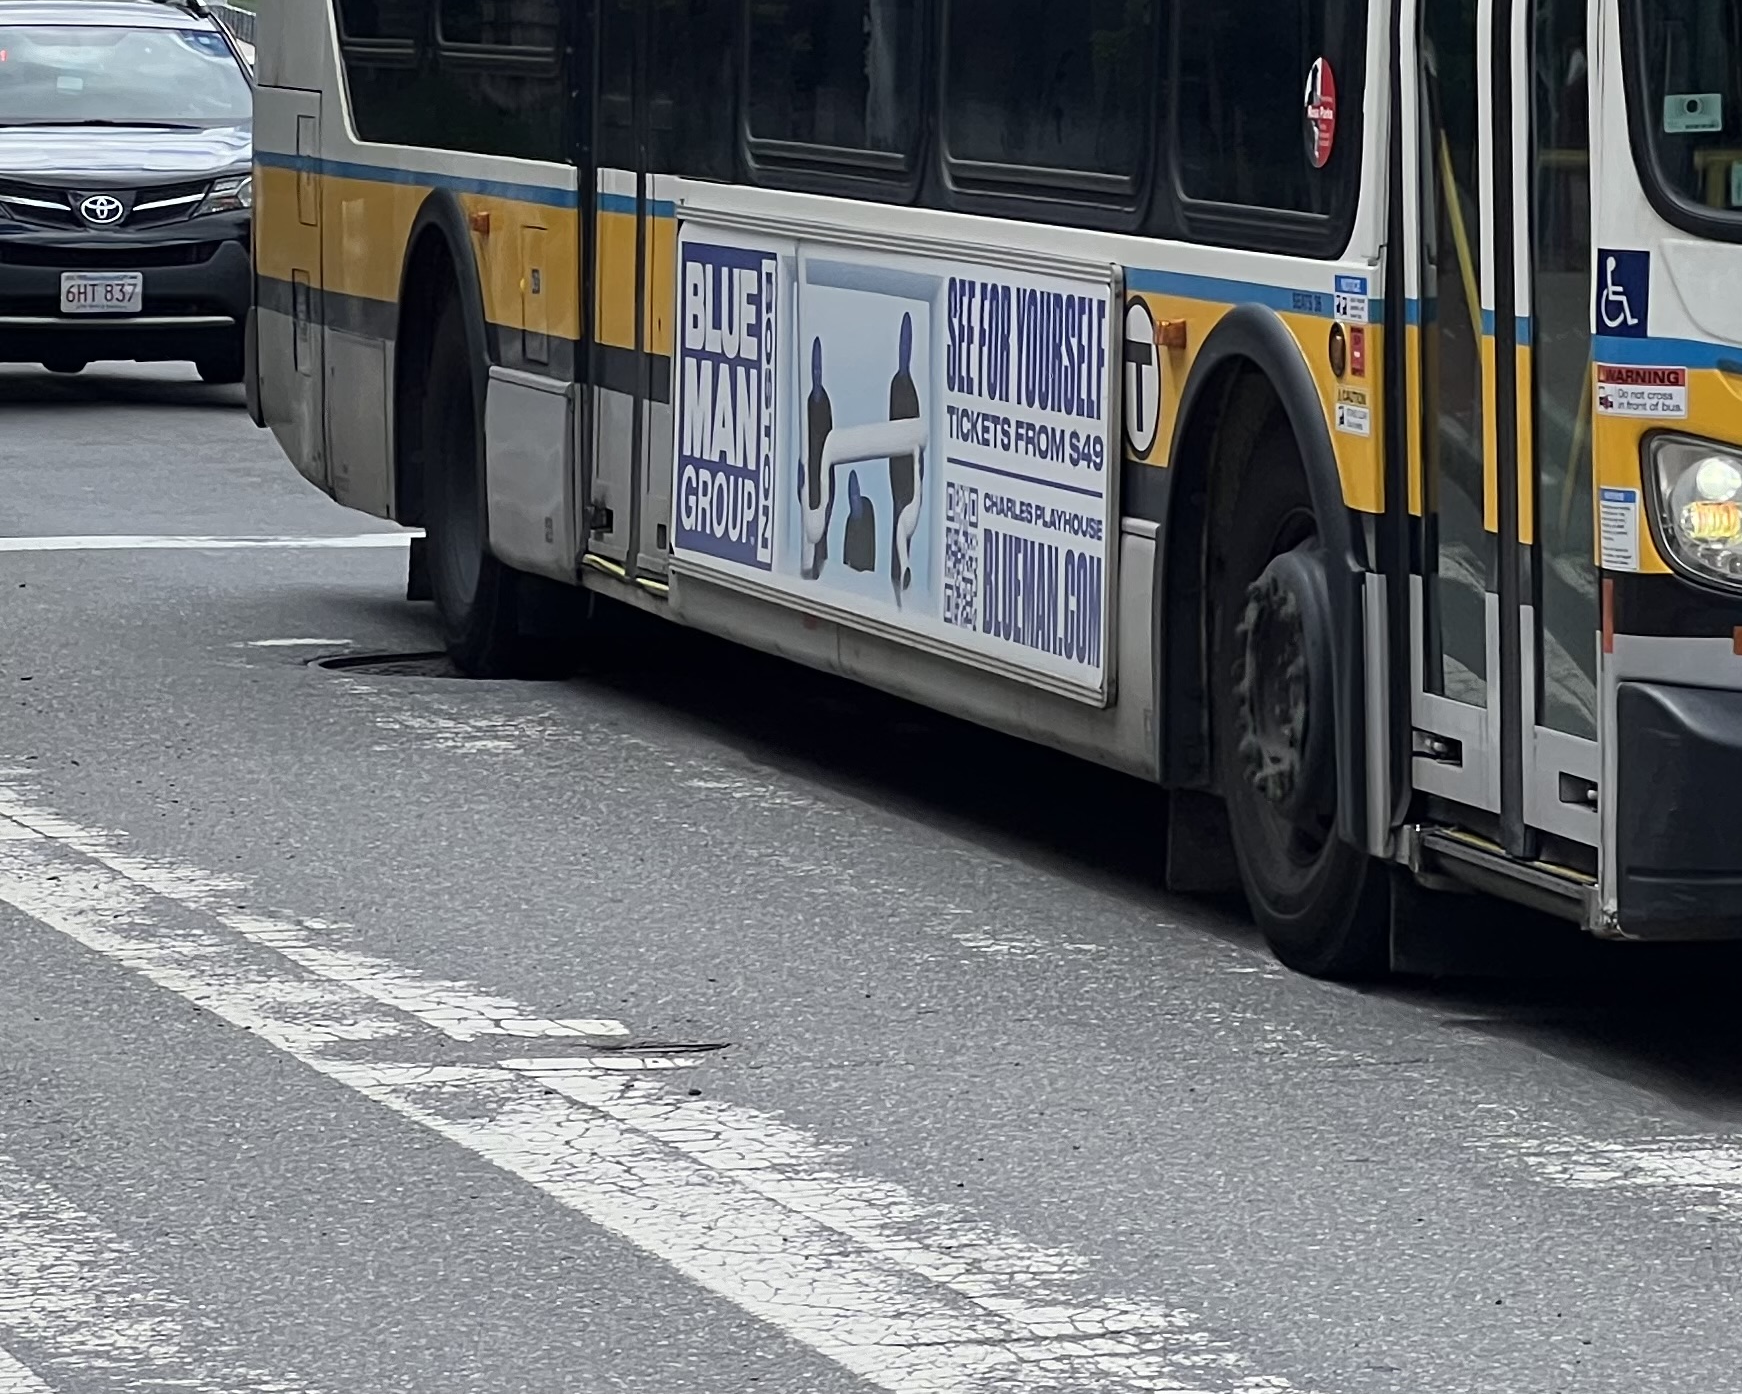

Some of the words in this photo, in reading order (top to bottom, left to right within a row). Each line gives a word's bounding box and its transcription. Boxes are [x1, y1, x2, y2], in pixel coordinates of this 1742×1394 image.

[66, 283, 98, 303] 6HT
[104, 283, 138, 303] 837
[685, 261, 758, 361] BLUE
[946, 277, 976, 396] SEE
[978, 282, 1011, 402] FOR
[1016, 287, 1106, 420] YOURSELF
[1606, 369, 1680, 385] WARNING
[683, 356, 758, 471] MAN
[761, 270, 774, 557] BOSTON
[1618, 388, 1629, 399] Do
[1630, 390, 1645, 400] not
[1647, 391, 1674, 401] cross
[1626, 399, 1648, 412] front
[1649, 400, 1660, 412] of
[946, 405, 1012, 452] TICKETS
[1014, 420, 1065, 464] FROM
[1068, 428, 1104, 472] $49
[983, 492, 1033, 525] CHARLES
[1034, 504, 1103, 542] PLAYHOUSE
[982, 527, 1102, 669] BLUEMAN.COM
